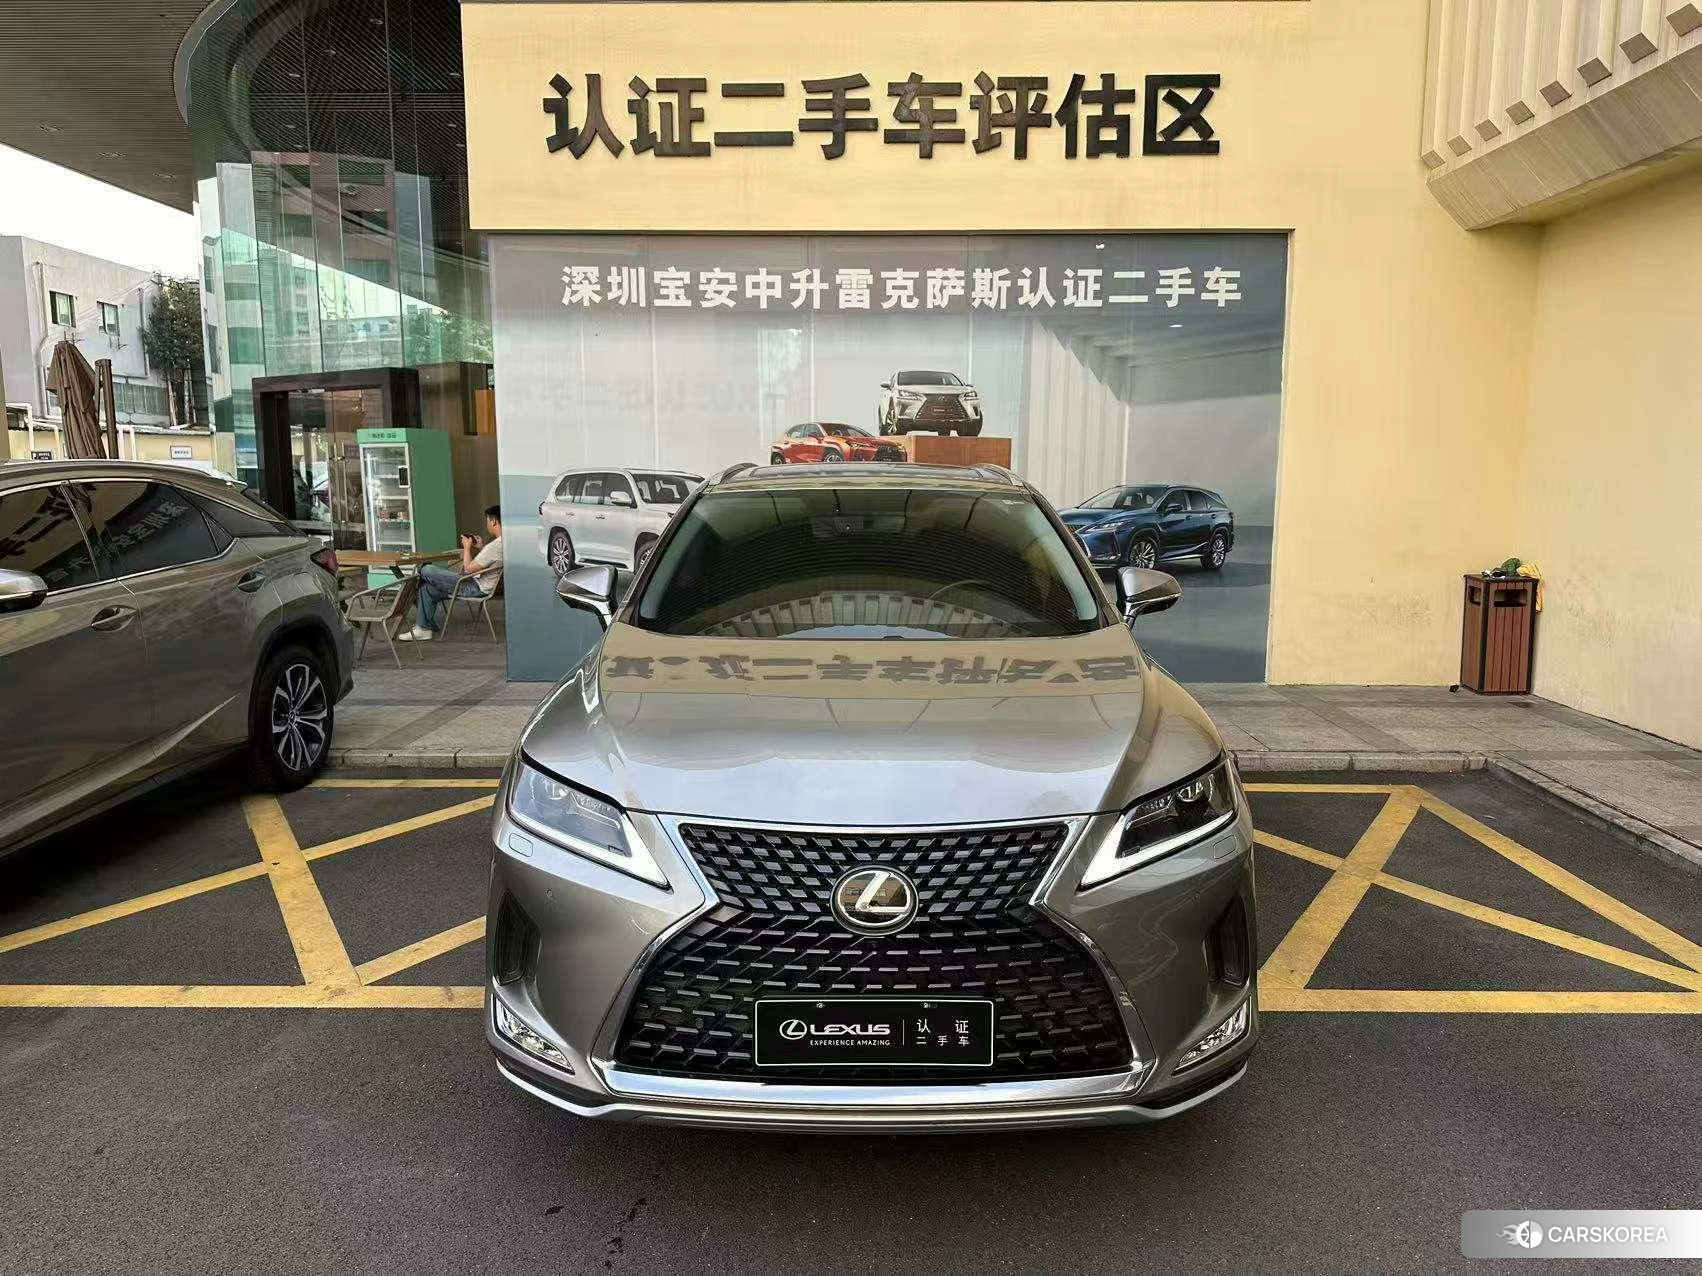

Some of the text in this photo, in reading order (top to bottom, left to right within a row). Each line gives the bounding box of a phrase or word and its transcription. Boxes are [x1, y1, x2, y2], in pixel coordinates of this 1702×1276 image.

[543, 72, 1221, 159] 认证二手车评估区
[560, 265, 1243, 310] 深圳宝安中升雷克萨斯认证二手车
[810, 1023, 891, 1036] LEXUS
[916, 1019, 970, 1034] 认证
[916, 1035, 970, 1047] 二手车
